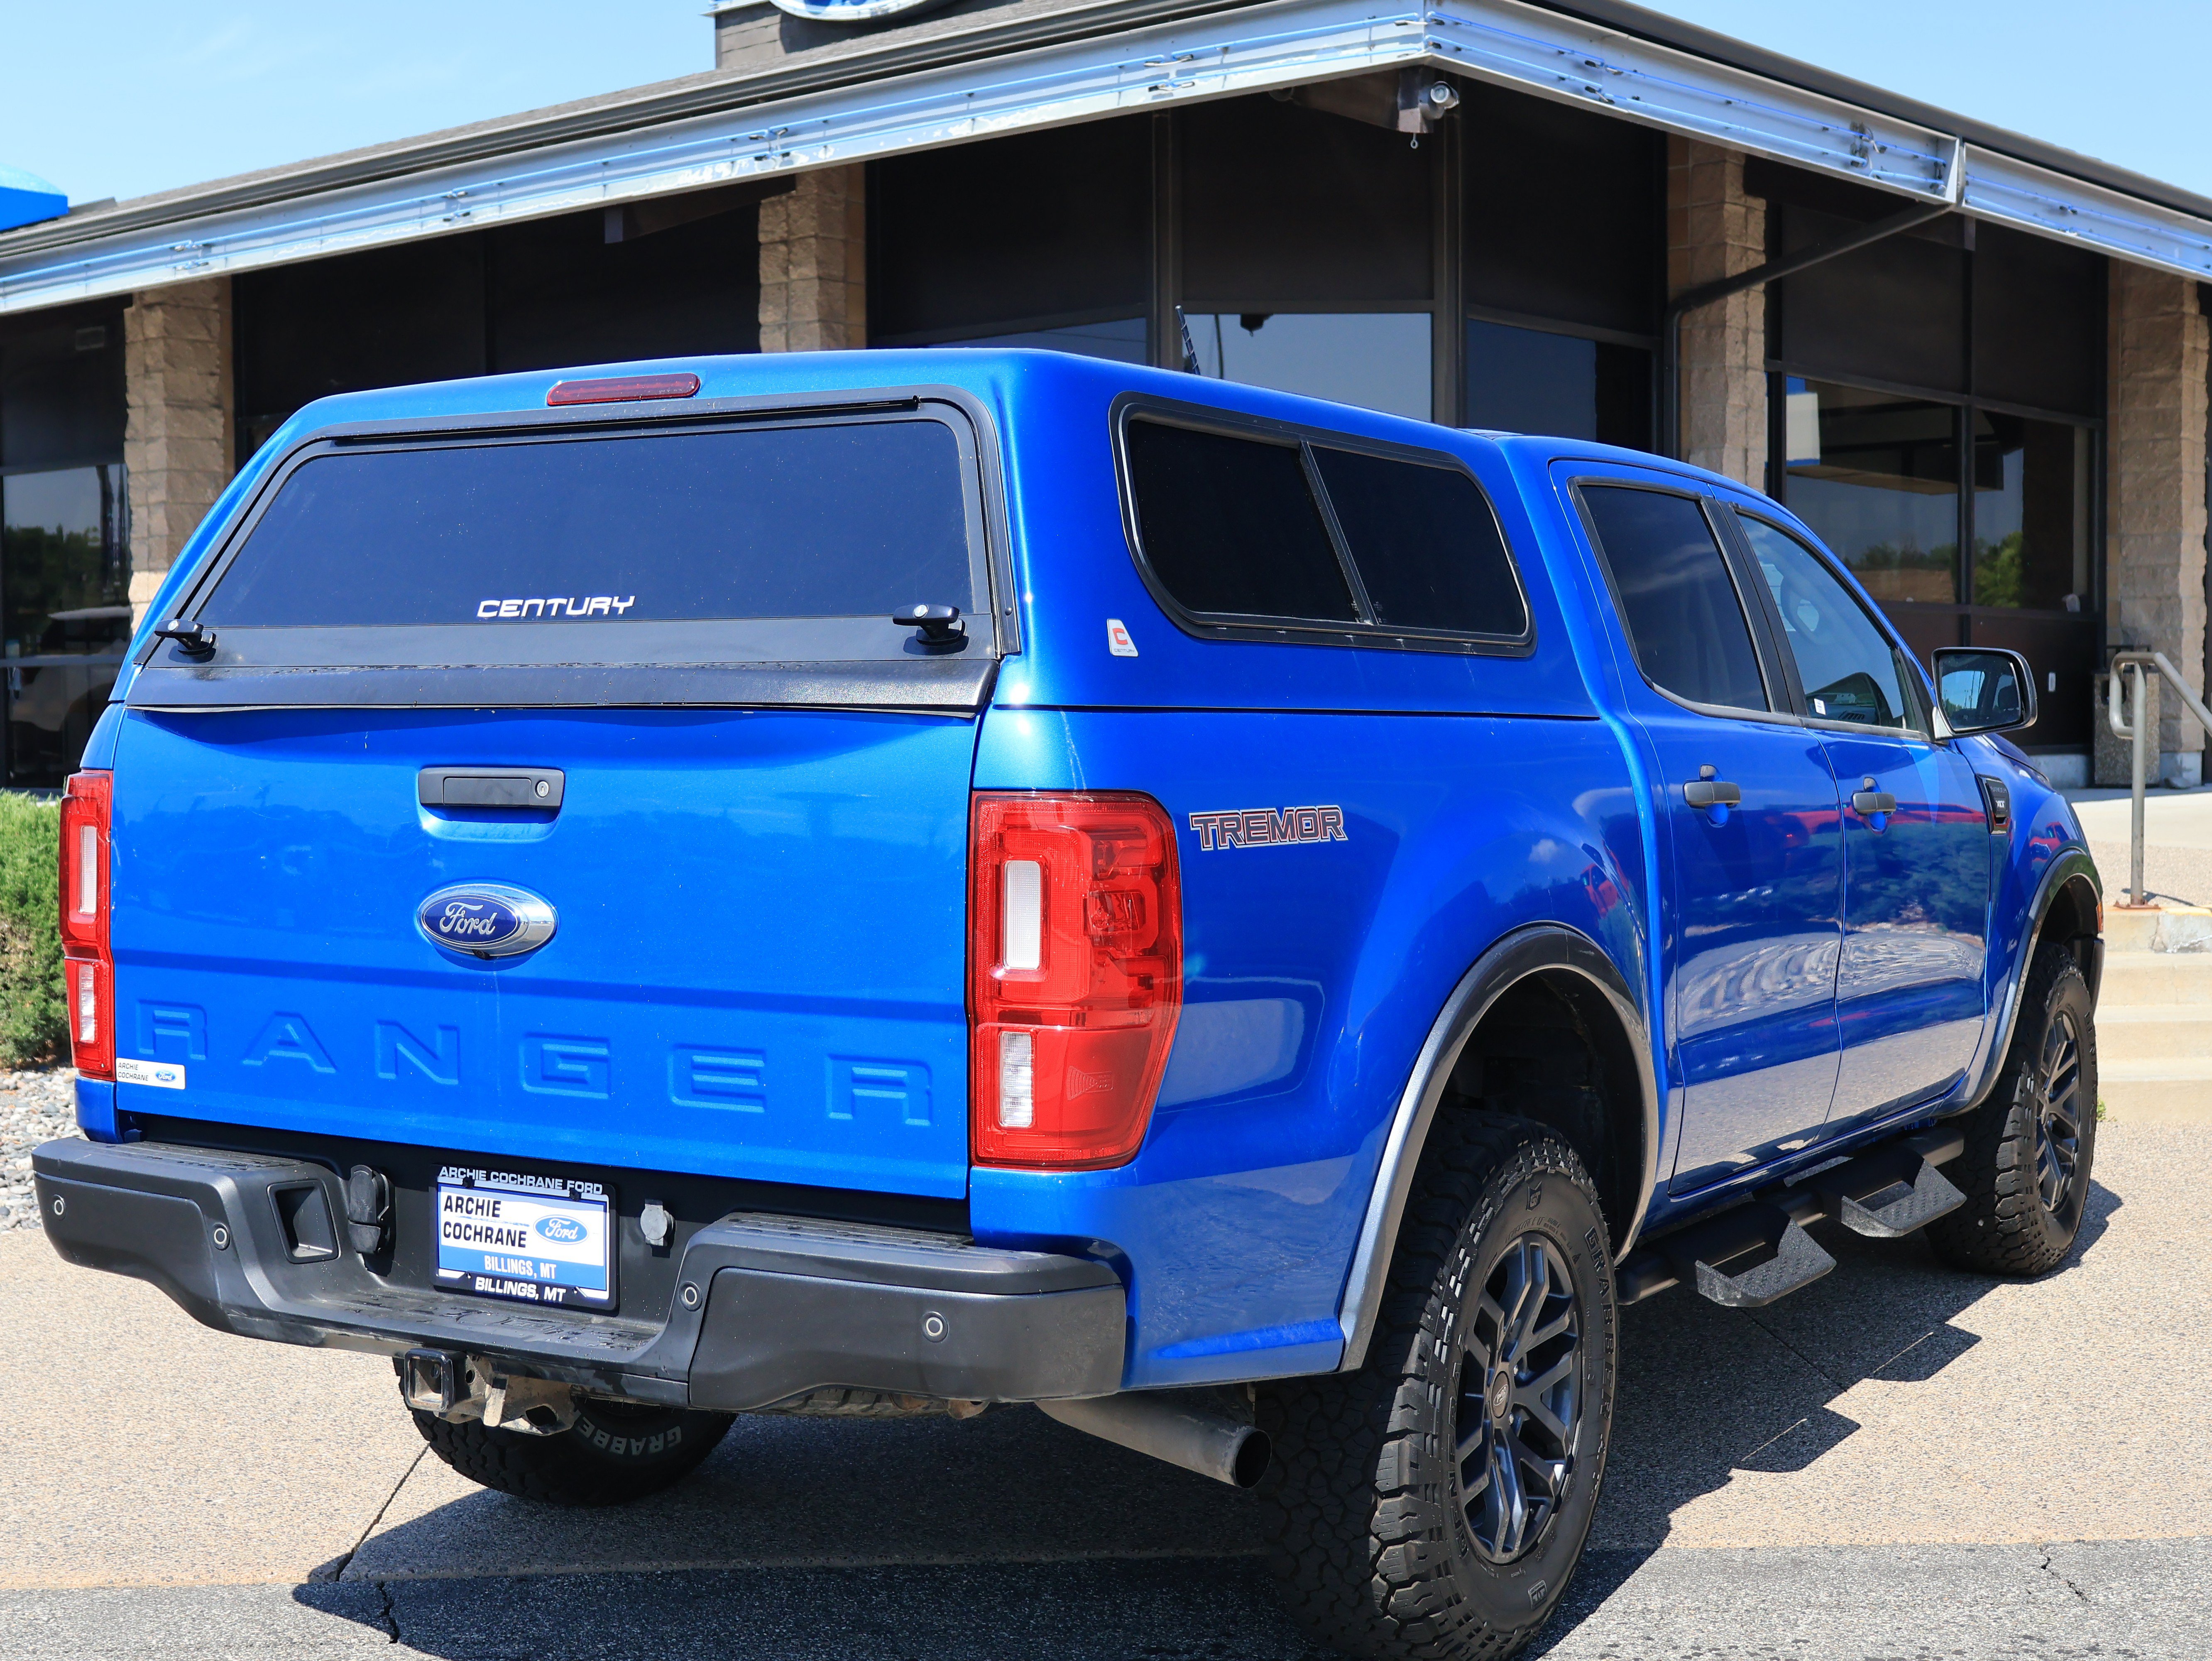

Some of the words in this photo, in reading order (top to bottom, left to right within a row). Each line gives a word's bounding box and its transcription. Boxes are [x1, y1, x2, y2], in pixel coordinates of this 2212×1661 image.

[477, 595, 635, 617] CENTURY
[1112, 627, 1128, 645] C
[1189, 805, 1348, 851] TREMOR
[439, 902, 497, 935] Ford
[118, 1062, 139, 1071] ARCHIE
[135, 999, 933, 1127] RANGER
[158, 1071, 173, 1080] Ford
[117, 1072, 149, 1081] COCHRANE
[439, 1166, 487, 1181] ARCHIE
[490, 1171, 563, 1190] COCHRANE
[567, 1181, 603, 1195] FORD
[443, 1195, 501, 1218] ARCHIE
[443, 1221, 527, 1248] COCHRANE
[545, 1217, 579, 1240] Ford
[484, 1255, 537, 1279] BILLINGS,
[540, 1262, 556, 1279] MT
[475, 1276, 539, 1300] BILLINGS,
[544, 1286, 566, 1302] MT
[1584, 1225, 1614, 1421] GRABBER
[573, 1409, 682, 1456] GRABBE
